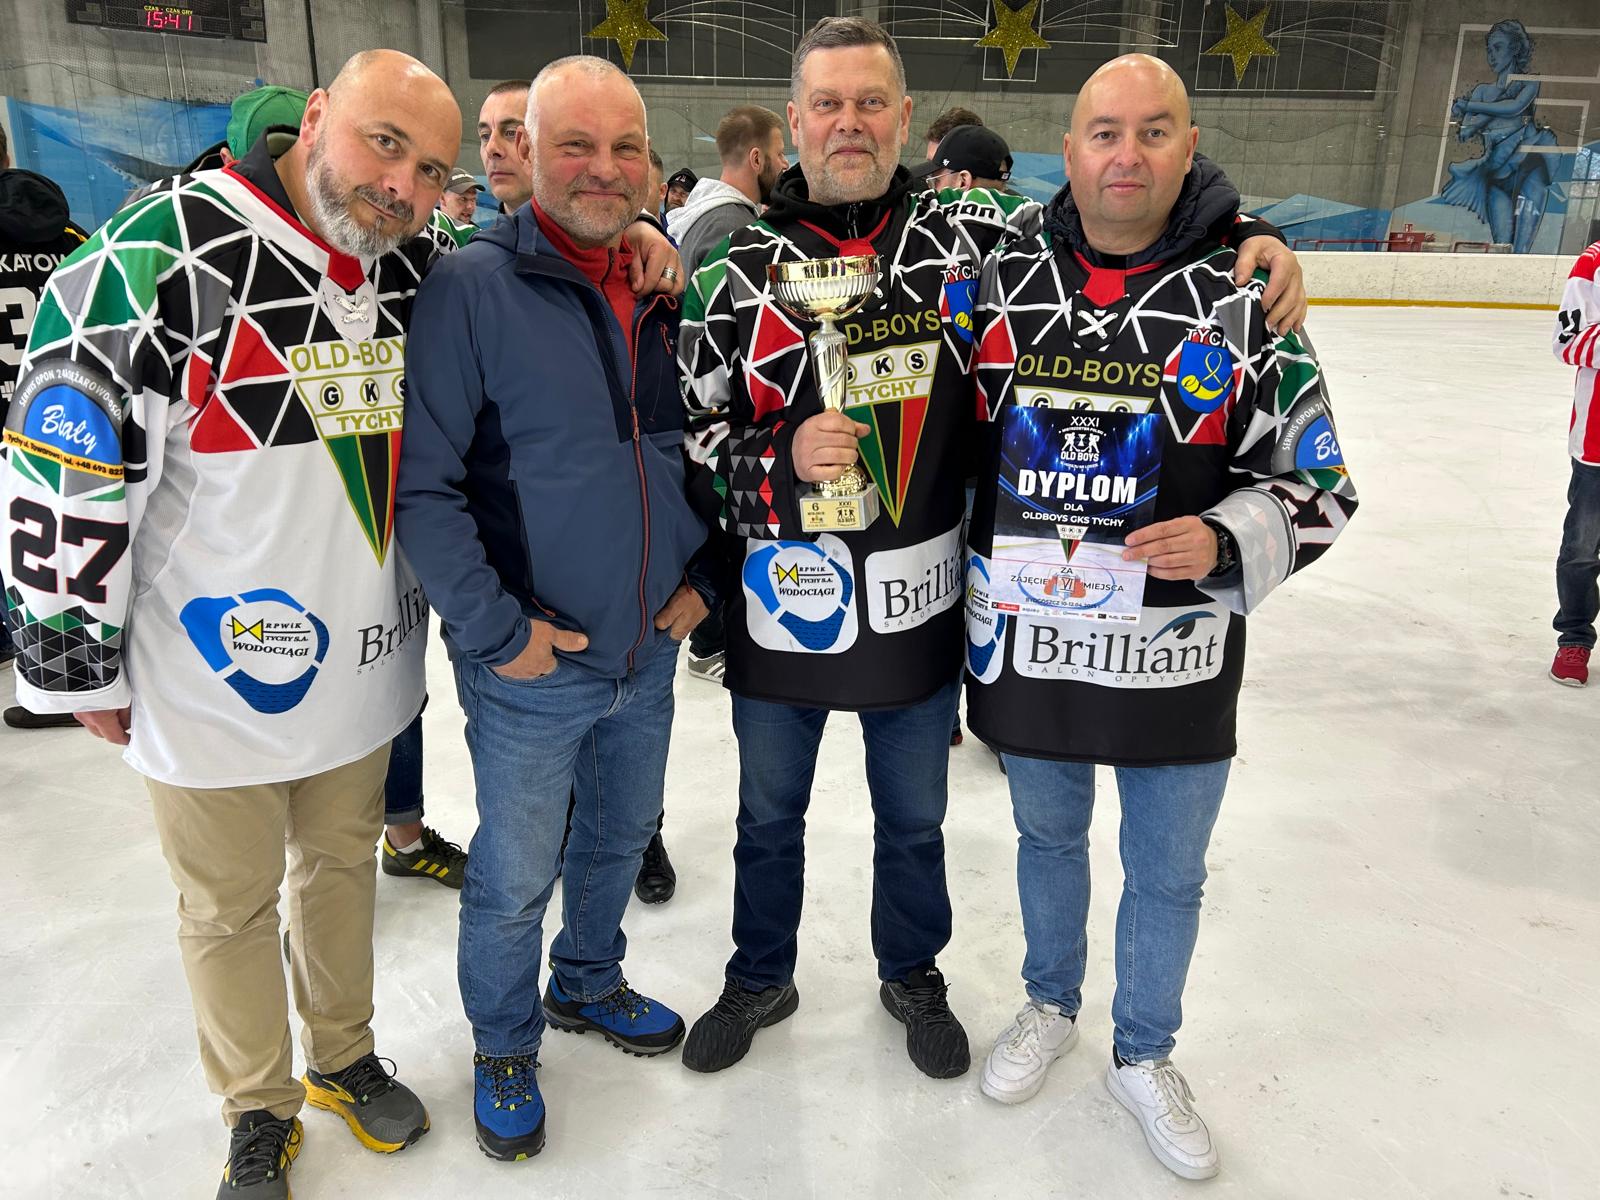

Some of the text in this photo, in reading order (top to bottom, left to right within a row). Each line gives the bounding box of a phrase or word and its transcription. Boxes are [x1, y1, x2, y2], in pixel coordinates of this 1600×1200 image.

[147, 11, 192, 31] 15:41
[940, 266, 980, 283] TYCH
[809, 309, 941, 345] D-BOYS
[1186, 327, 1226, 348] TYC
[291, 339, 404, 372] OLD-BOY
[1017, 354, 1161, 387] OLD-BOYS
[850, 381, 917, 403] TYCHY
[336, 410, 403, 432] TYCHY
[1070, 416, 1100, 427] XXXI
[1282, 425, 1299, 451] SERWIS
[1297, 406, 1316, 425] OPON
[1060, 451, 1100, 462] OLD BOYS
[1018, 469, 1137, 504] DYPLOM
[812, 502, 820, 512] 6
[1063, 503, 1084, 512] DLA
[1022, 511, 1124, 527] OLDBOYS GKS TYCHY
[9, 496, 130, 604] 27
[1060, 566, 1074, 575] ZA
[779, 587, 835, 597] WODOCIĄGI
[879, 556, 960, 619] Brillia
[1011, 575, 1124, 592] ZAJĘCIE VI MIEJSCA
[358, 587, 430, 667] Brillia
[233, 641, 309, 657] WODOCIĄGI
[1028, 624, 1218, 674] Brilliant
[1026, 664, 1094, 678] SALON
